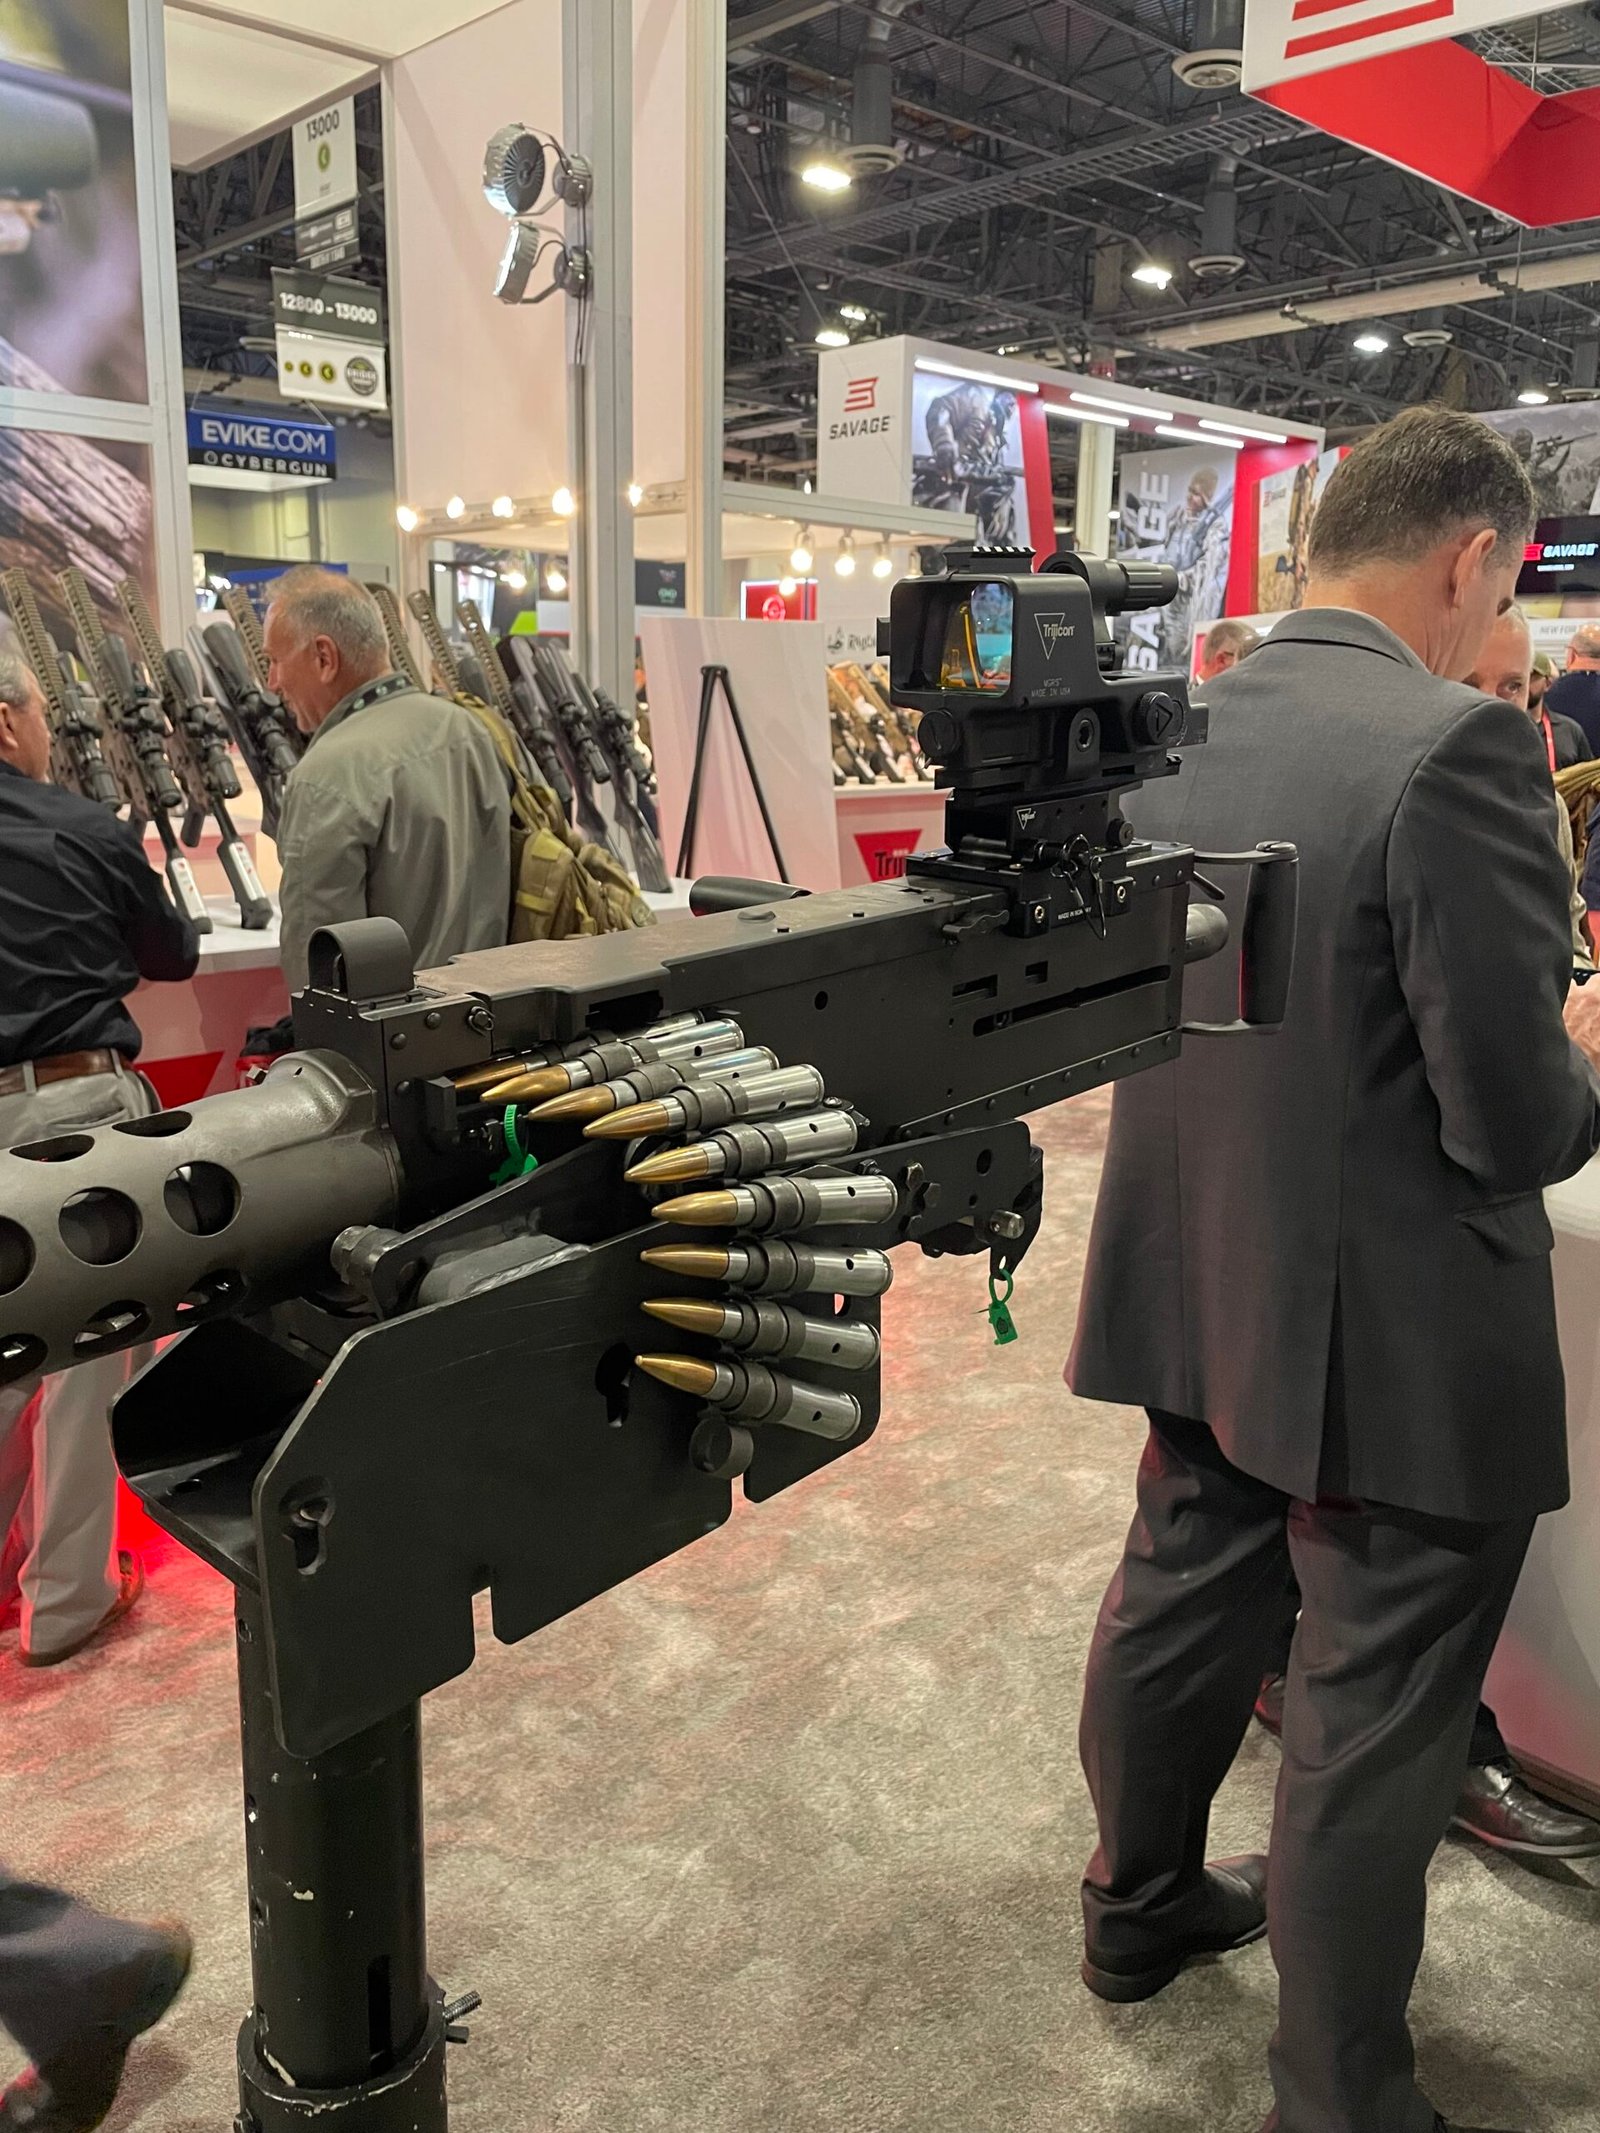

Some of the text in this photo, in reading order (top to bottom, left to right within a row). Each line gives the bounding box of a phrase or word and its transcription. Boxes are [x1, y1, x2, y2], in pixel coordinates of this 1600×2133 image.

[306, 109, 340, 141] 13000
[334, 302, 378, 325] 13000
[201, 418, 327, 456] EVIKE.COM
[829, 415, 891, 440] SAVAGE
[221, 453, 328, 477] CYBERGUN
[1127, 471, 1170, 671] SAGE
[1043, 624, 1075, 640] Trijicon
